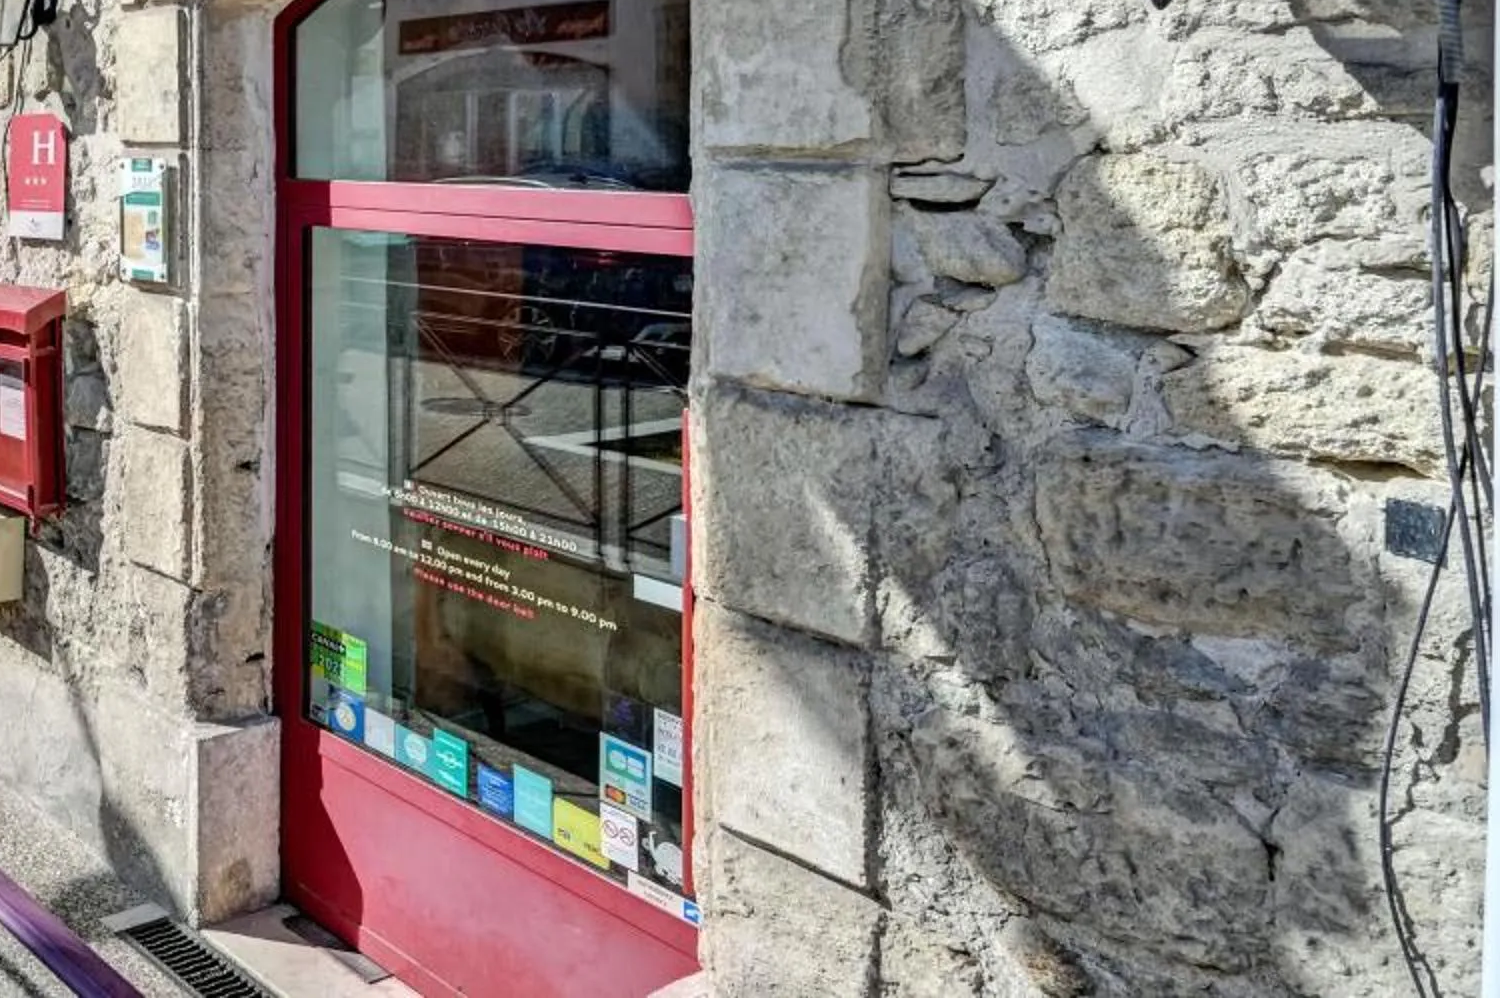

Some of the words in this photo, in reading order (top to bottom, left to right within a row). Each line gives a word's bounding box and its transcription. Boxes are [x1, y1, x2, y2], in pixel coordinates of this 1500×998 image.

[32, 130, 56, 165] H
[540, 533, 578, 553] 21h00
[437, 546, 462, 562] Open
[463, 557, 491, 573] every
[491, 564, 511, 581] day
[420, 553, 448, 571] 12.00
[465, 570, 483, 583] and
[485, 576, 510, 593] from
[511, 585, 536, 602] 3.00
[537, 596, 555, 609] pm
[555, 601, 569, 614] to
[569, 605, 597, 623] 9.00
[598, 617, 618, 631] pm
